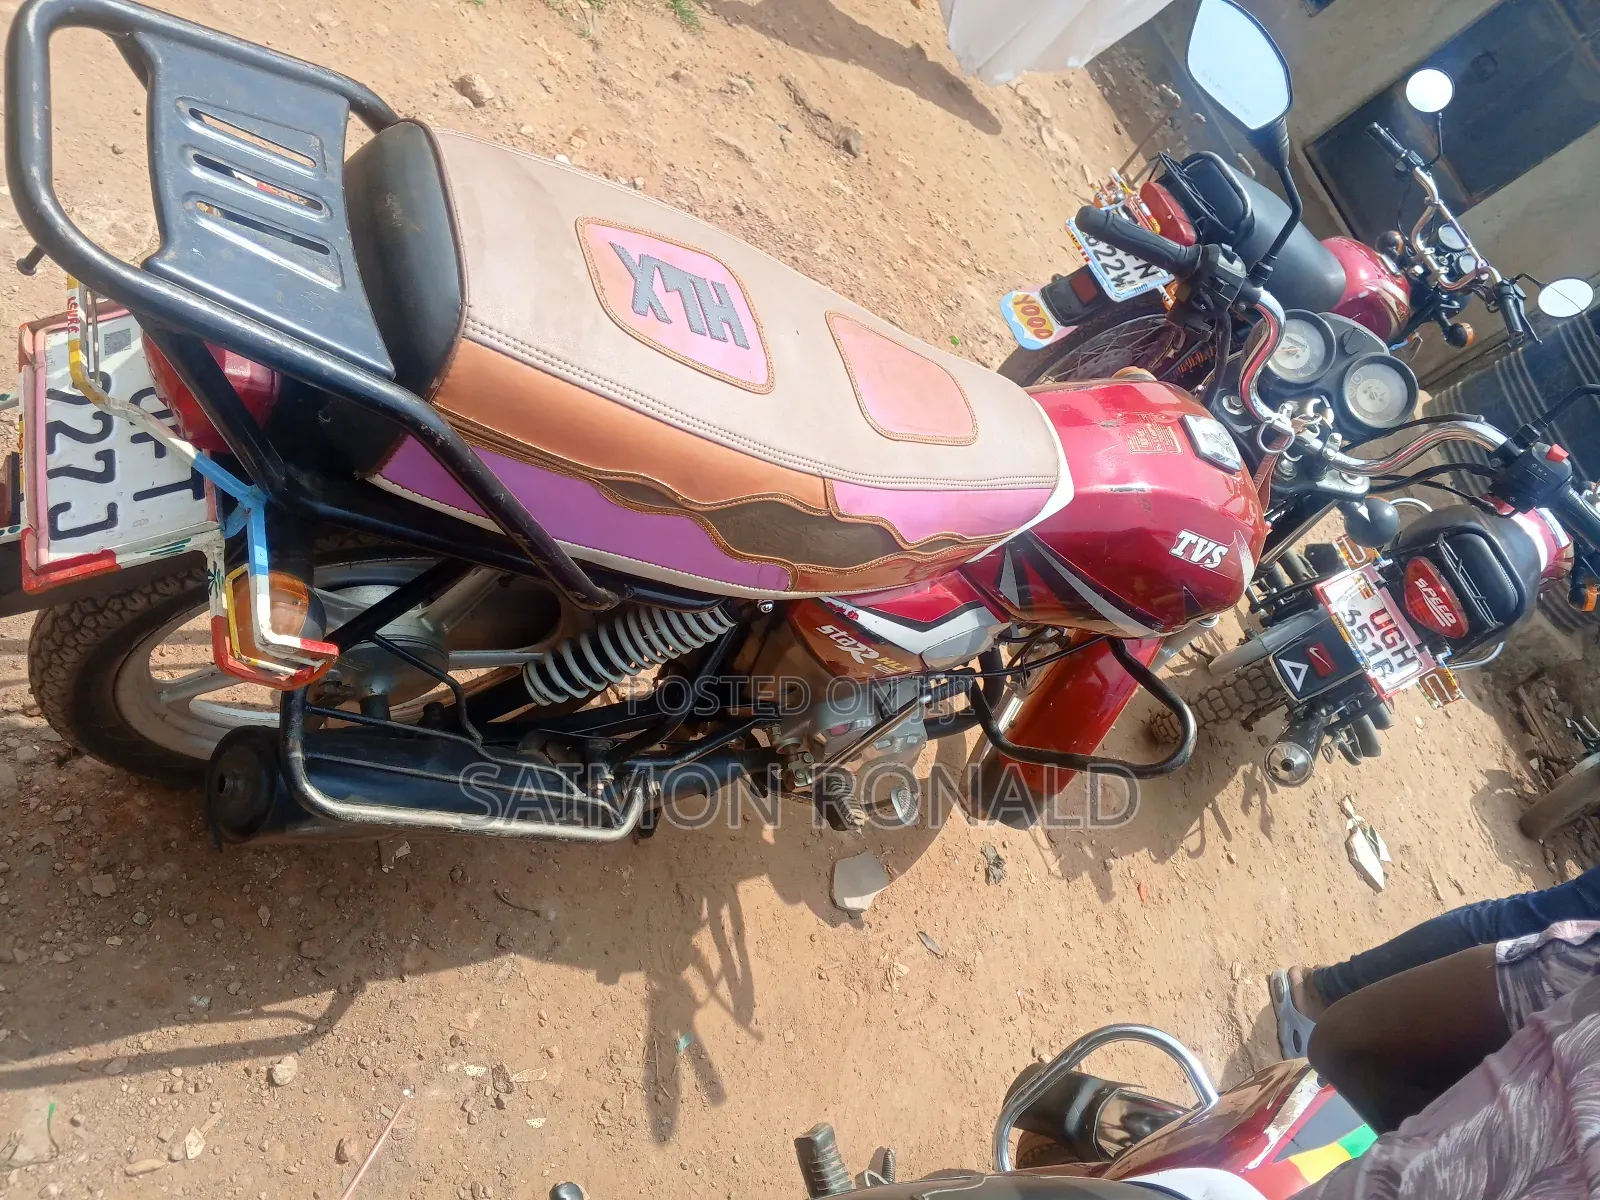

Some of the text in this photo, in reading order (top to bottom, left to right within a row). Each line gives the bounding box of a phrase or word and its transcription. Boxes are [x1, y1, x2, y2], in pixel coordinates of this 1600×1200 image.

[610, 241, 750, 350] HLX
[1171, 529, 1229, 569] TVS
[1413, 578, 1457, 624] SPEED
[1370, 607, 1420, 668] UGH
